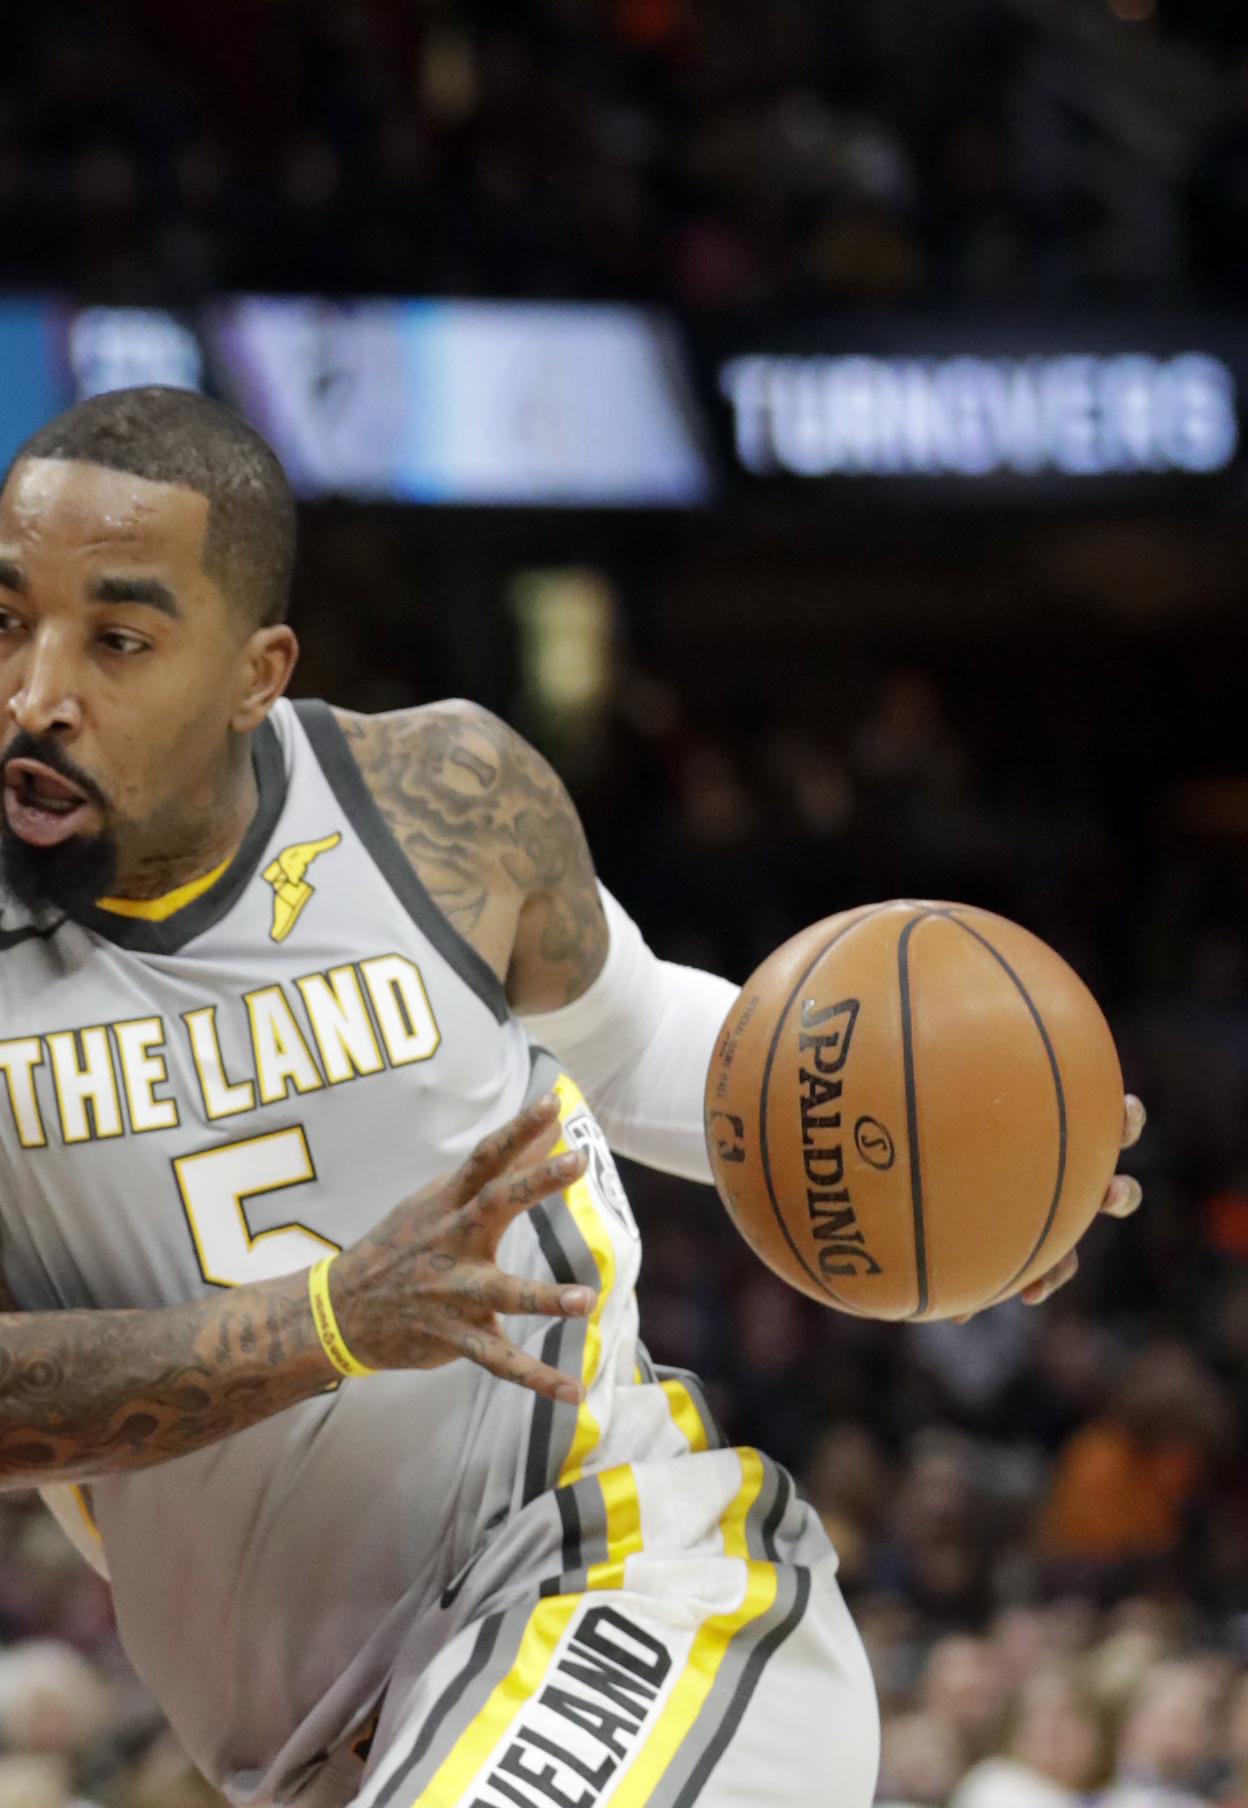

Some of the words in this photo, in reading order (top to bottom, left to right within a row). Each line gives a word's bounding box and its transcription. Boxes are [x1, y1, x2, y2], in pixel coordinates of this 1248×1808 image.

[182, 953, 441, 1122] LAND
[171, 1123, 343, 1289] 5
[799, 998, 883, 1278] SPALDING
